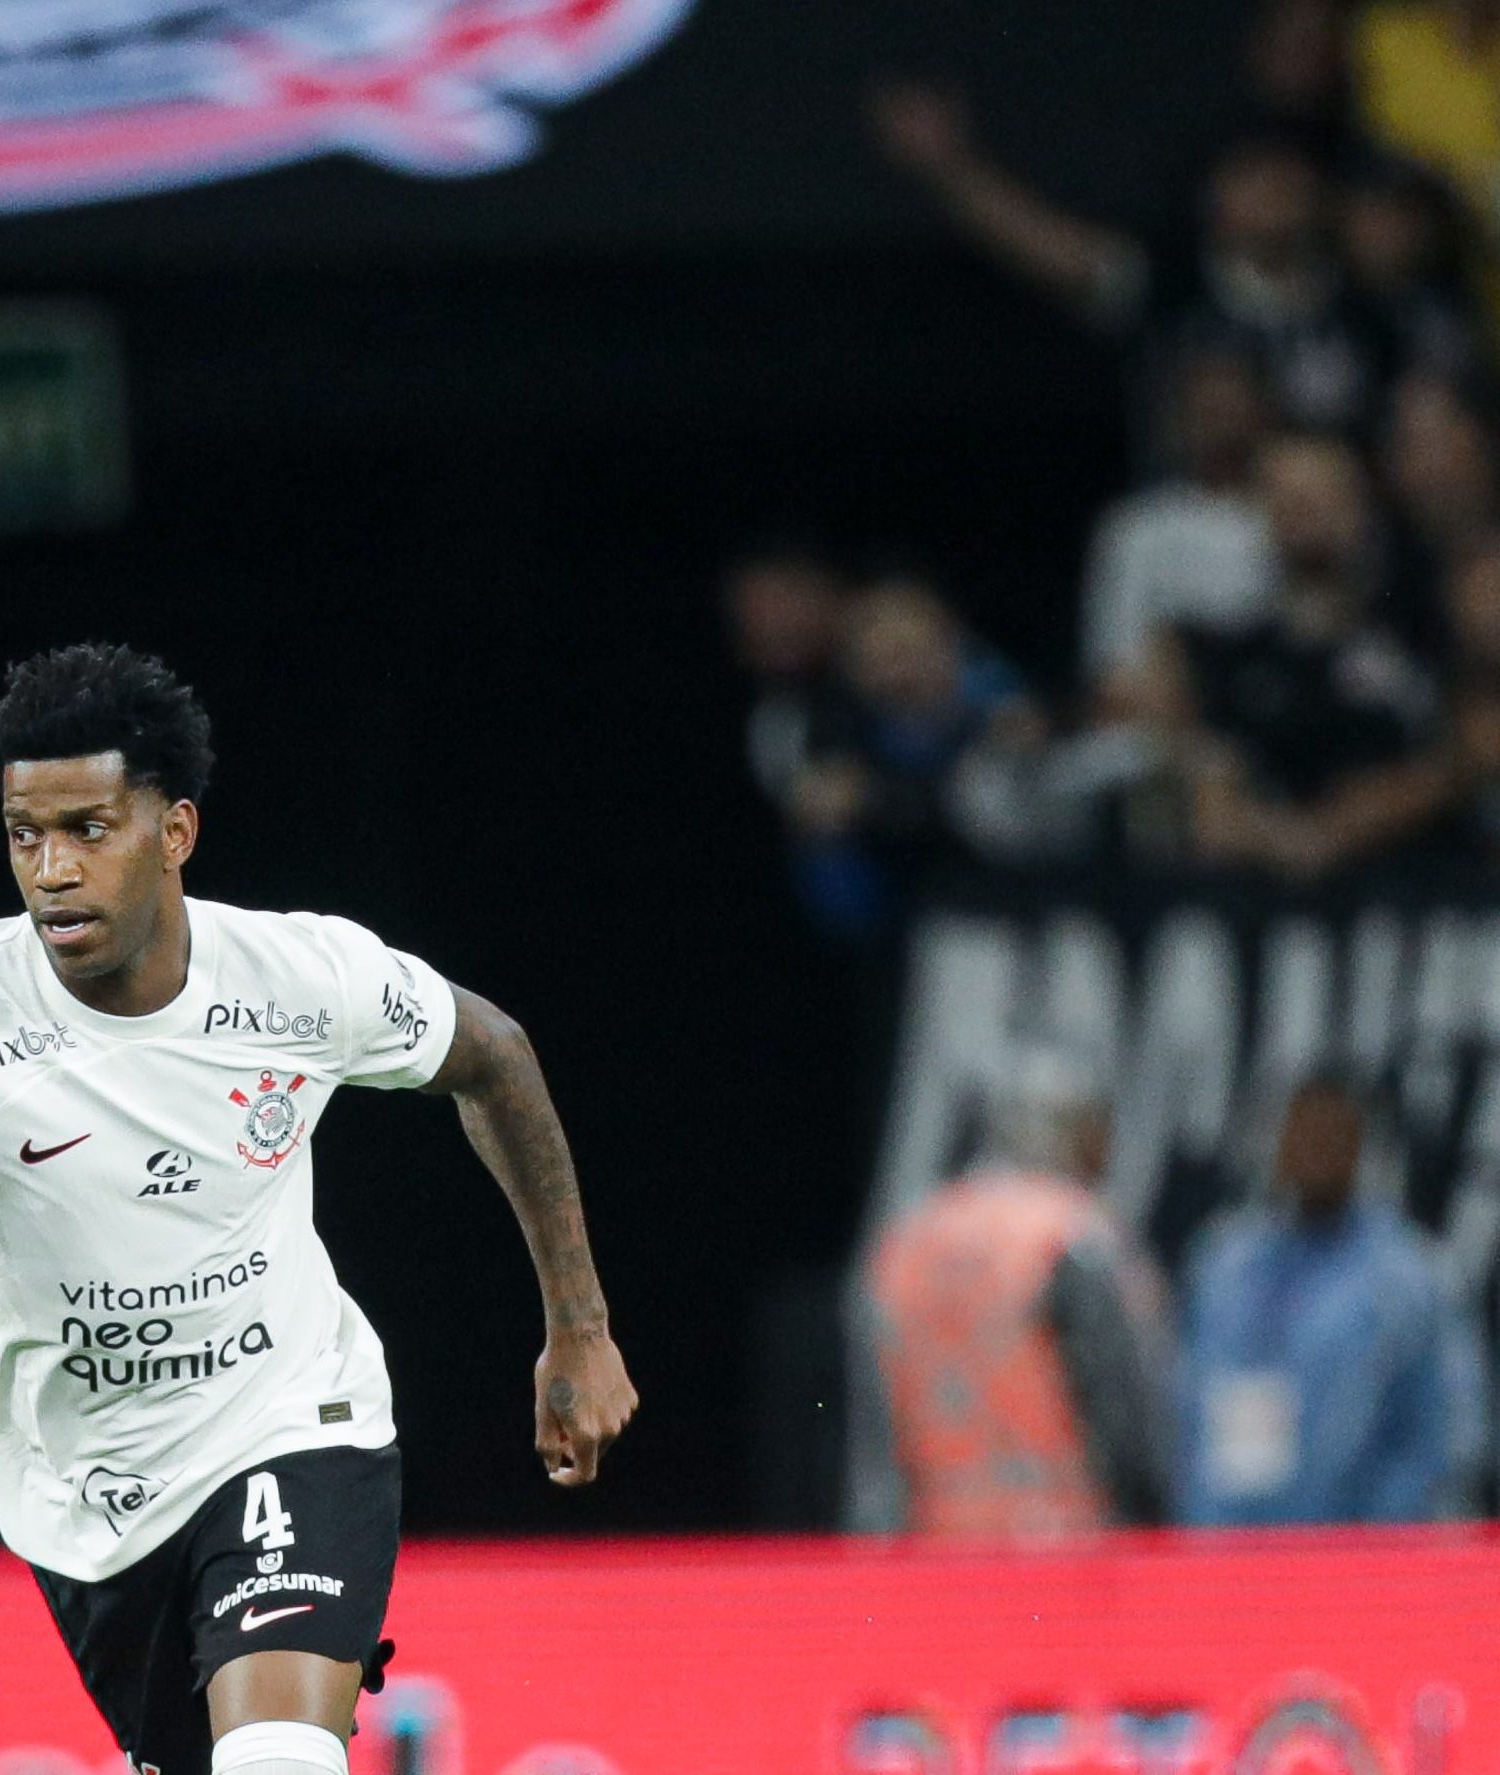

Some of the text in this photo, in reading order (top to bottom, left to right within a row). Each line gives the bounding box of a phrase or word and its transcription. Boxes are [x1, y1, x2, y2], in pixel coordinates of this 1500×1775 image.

[204, 999, 333, 1040] pixbet
[390, 991, 428, 1051] bmg
[137, 1179, 202, 1197] ALE
[59, 1250, 268, 1311] vitaminas
[61, 1321, 274, 1393] química
[62, 1317, 173, 1349] neo
[242, 1471, 295, 1550] 4
